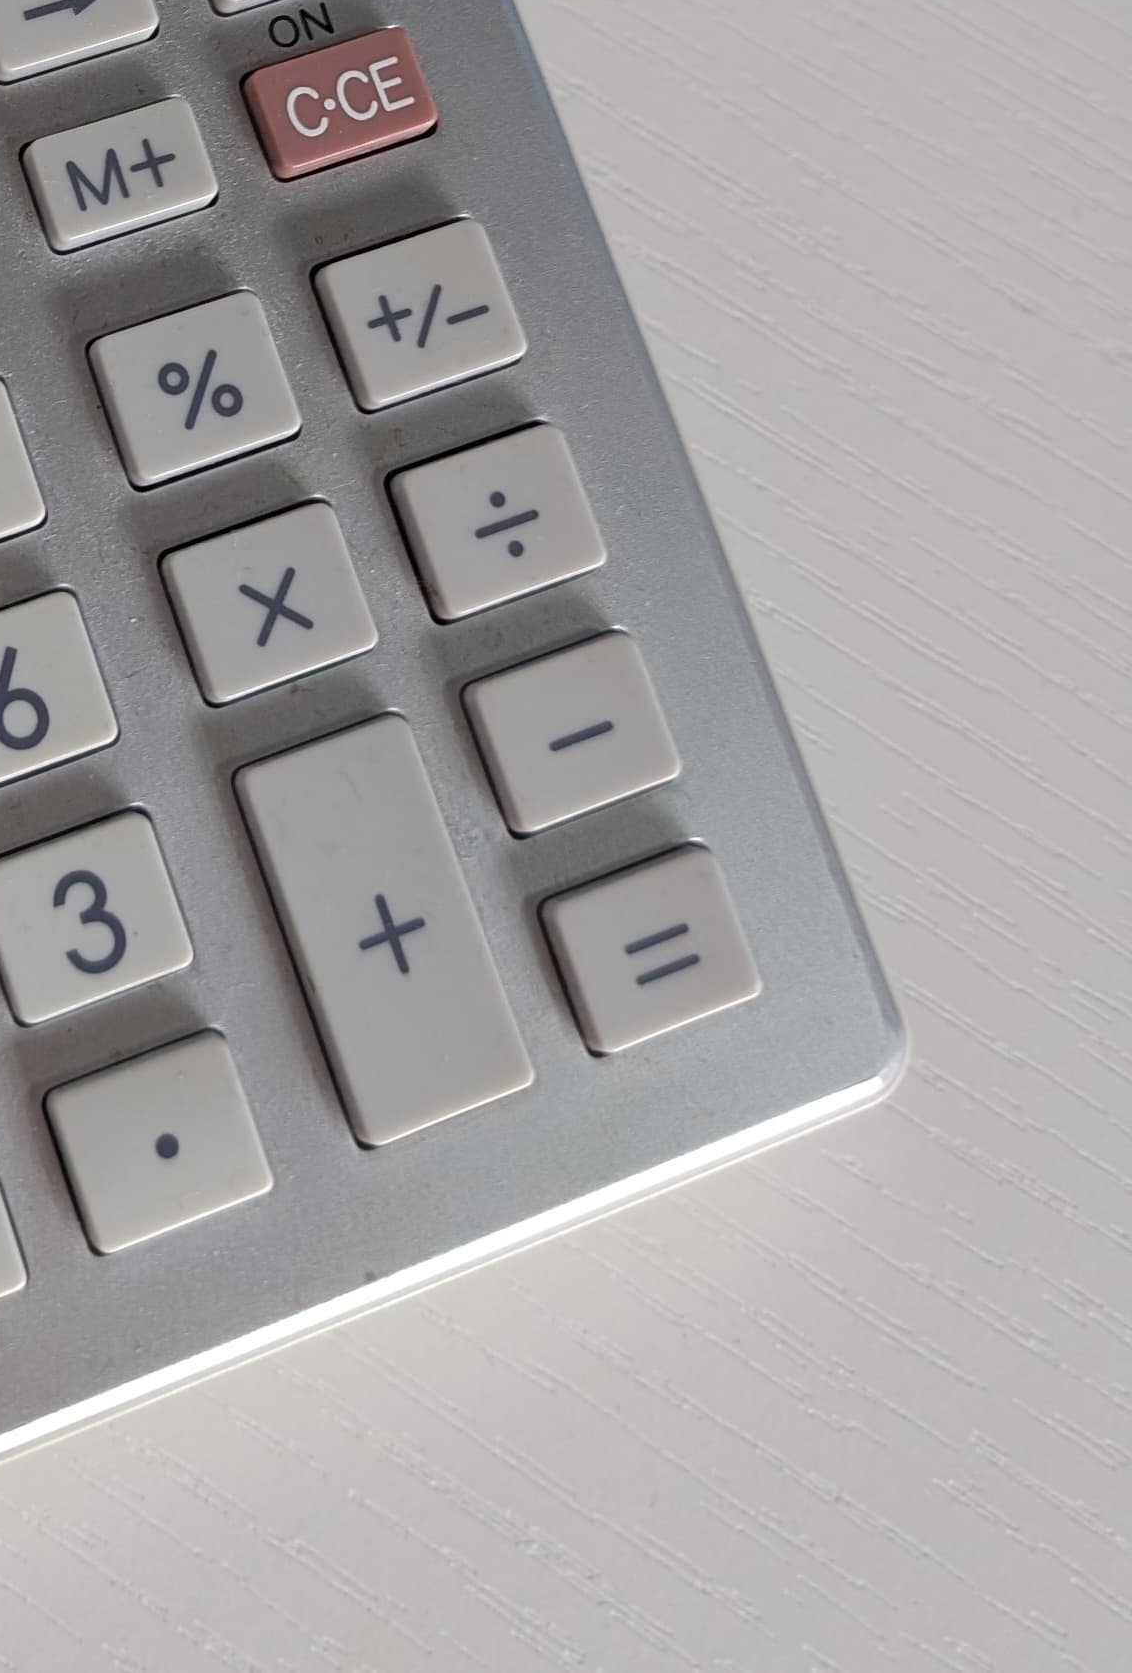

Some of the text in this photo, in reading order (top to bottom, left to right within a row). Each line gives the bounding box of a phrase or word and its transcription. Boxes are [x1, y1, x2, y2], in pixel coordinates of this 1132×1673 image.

[268, 2, 336, 47] ON
[66, 138, 176, 211] M+
[158, 349, 244, 430] %
[51, 868, 128, 974] 3
